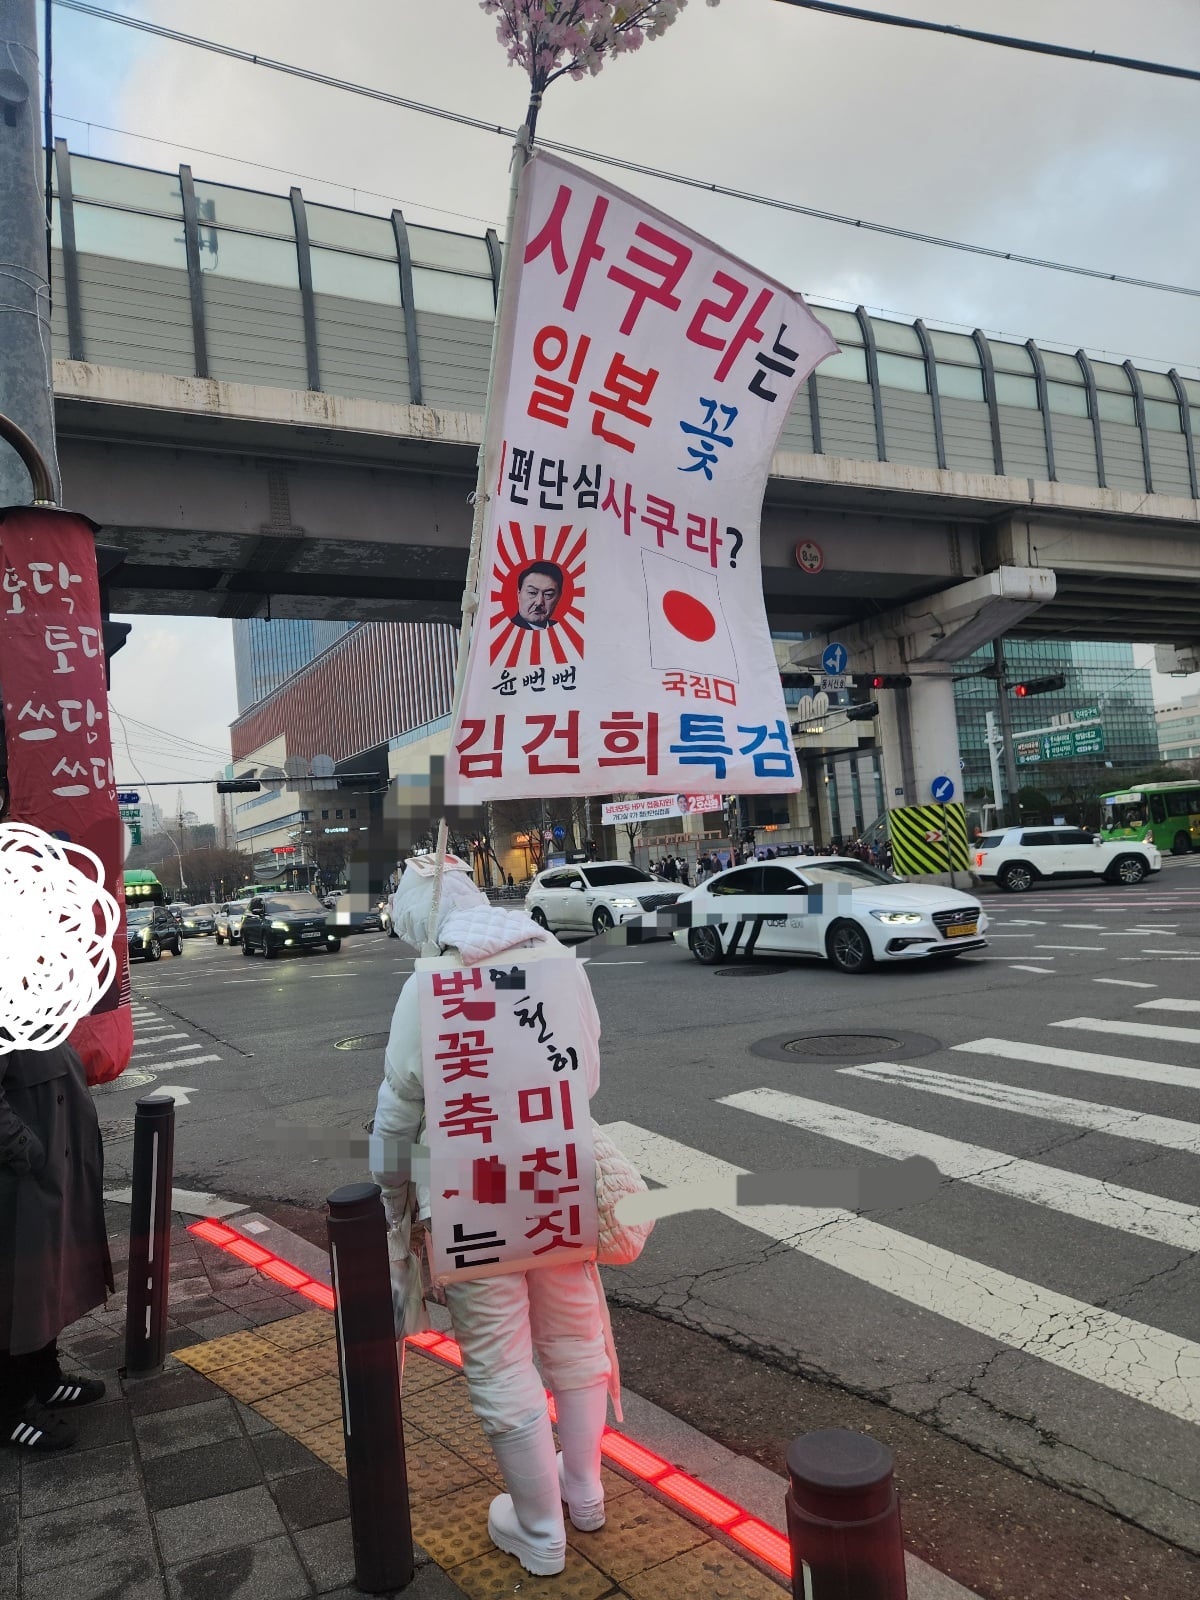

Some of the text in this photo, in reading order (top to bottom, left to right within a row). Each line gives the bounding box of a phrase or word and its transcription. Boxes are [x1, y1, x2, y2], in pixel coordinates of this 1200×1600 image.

[523, 185, 799, 402] 사쿠라는
[527, 325, 738, 480] 일본 꽃
[602, 477, 743, 568] 사쿠라?
[821, 678, 845, 689] 동시신호
[18, 699, 103, 744] 쓰담
[456, 710, 795, 779] 김건희 특검
[631, 801, 645, 811] HPV
